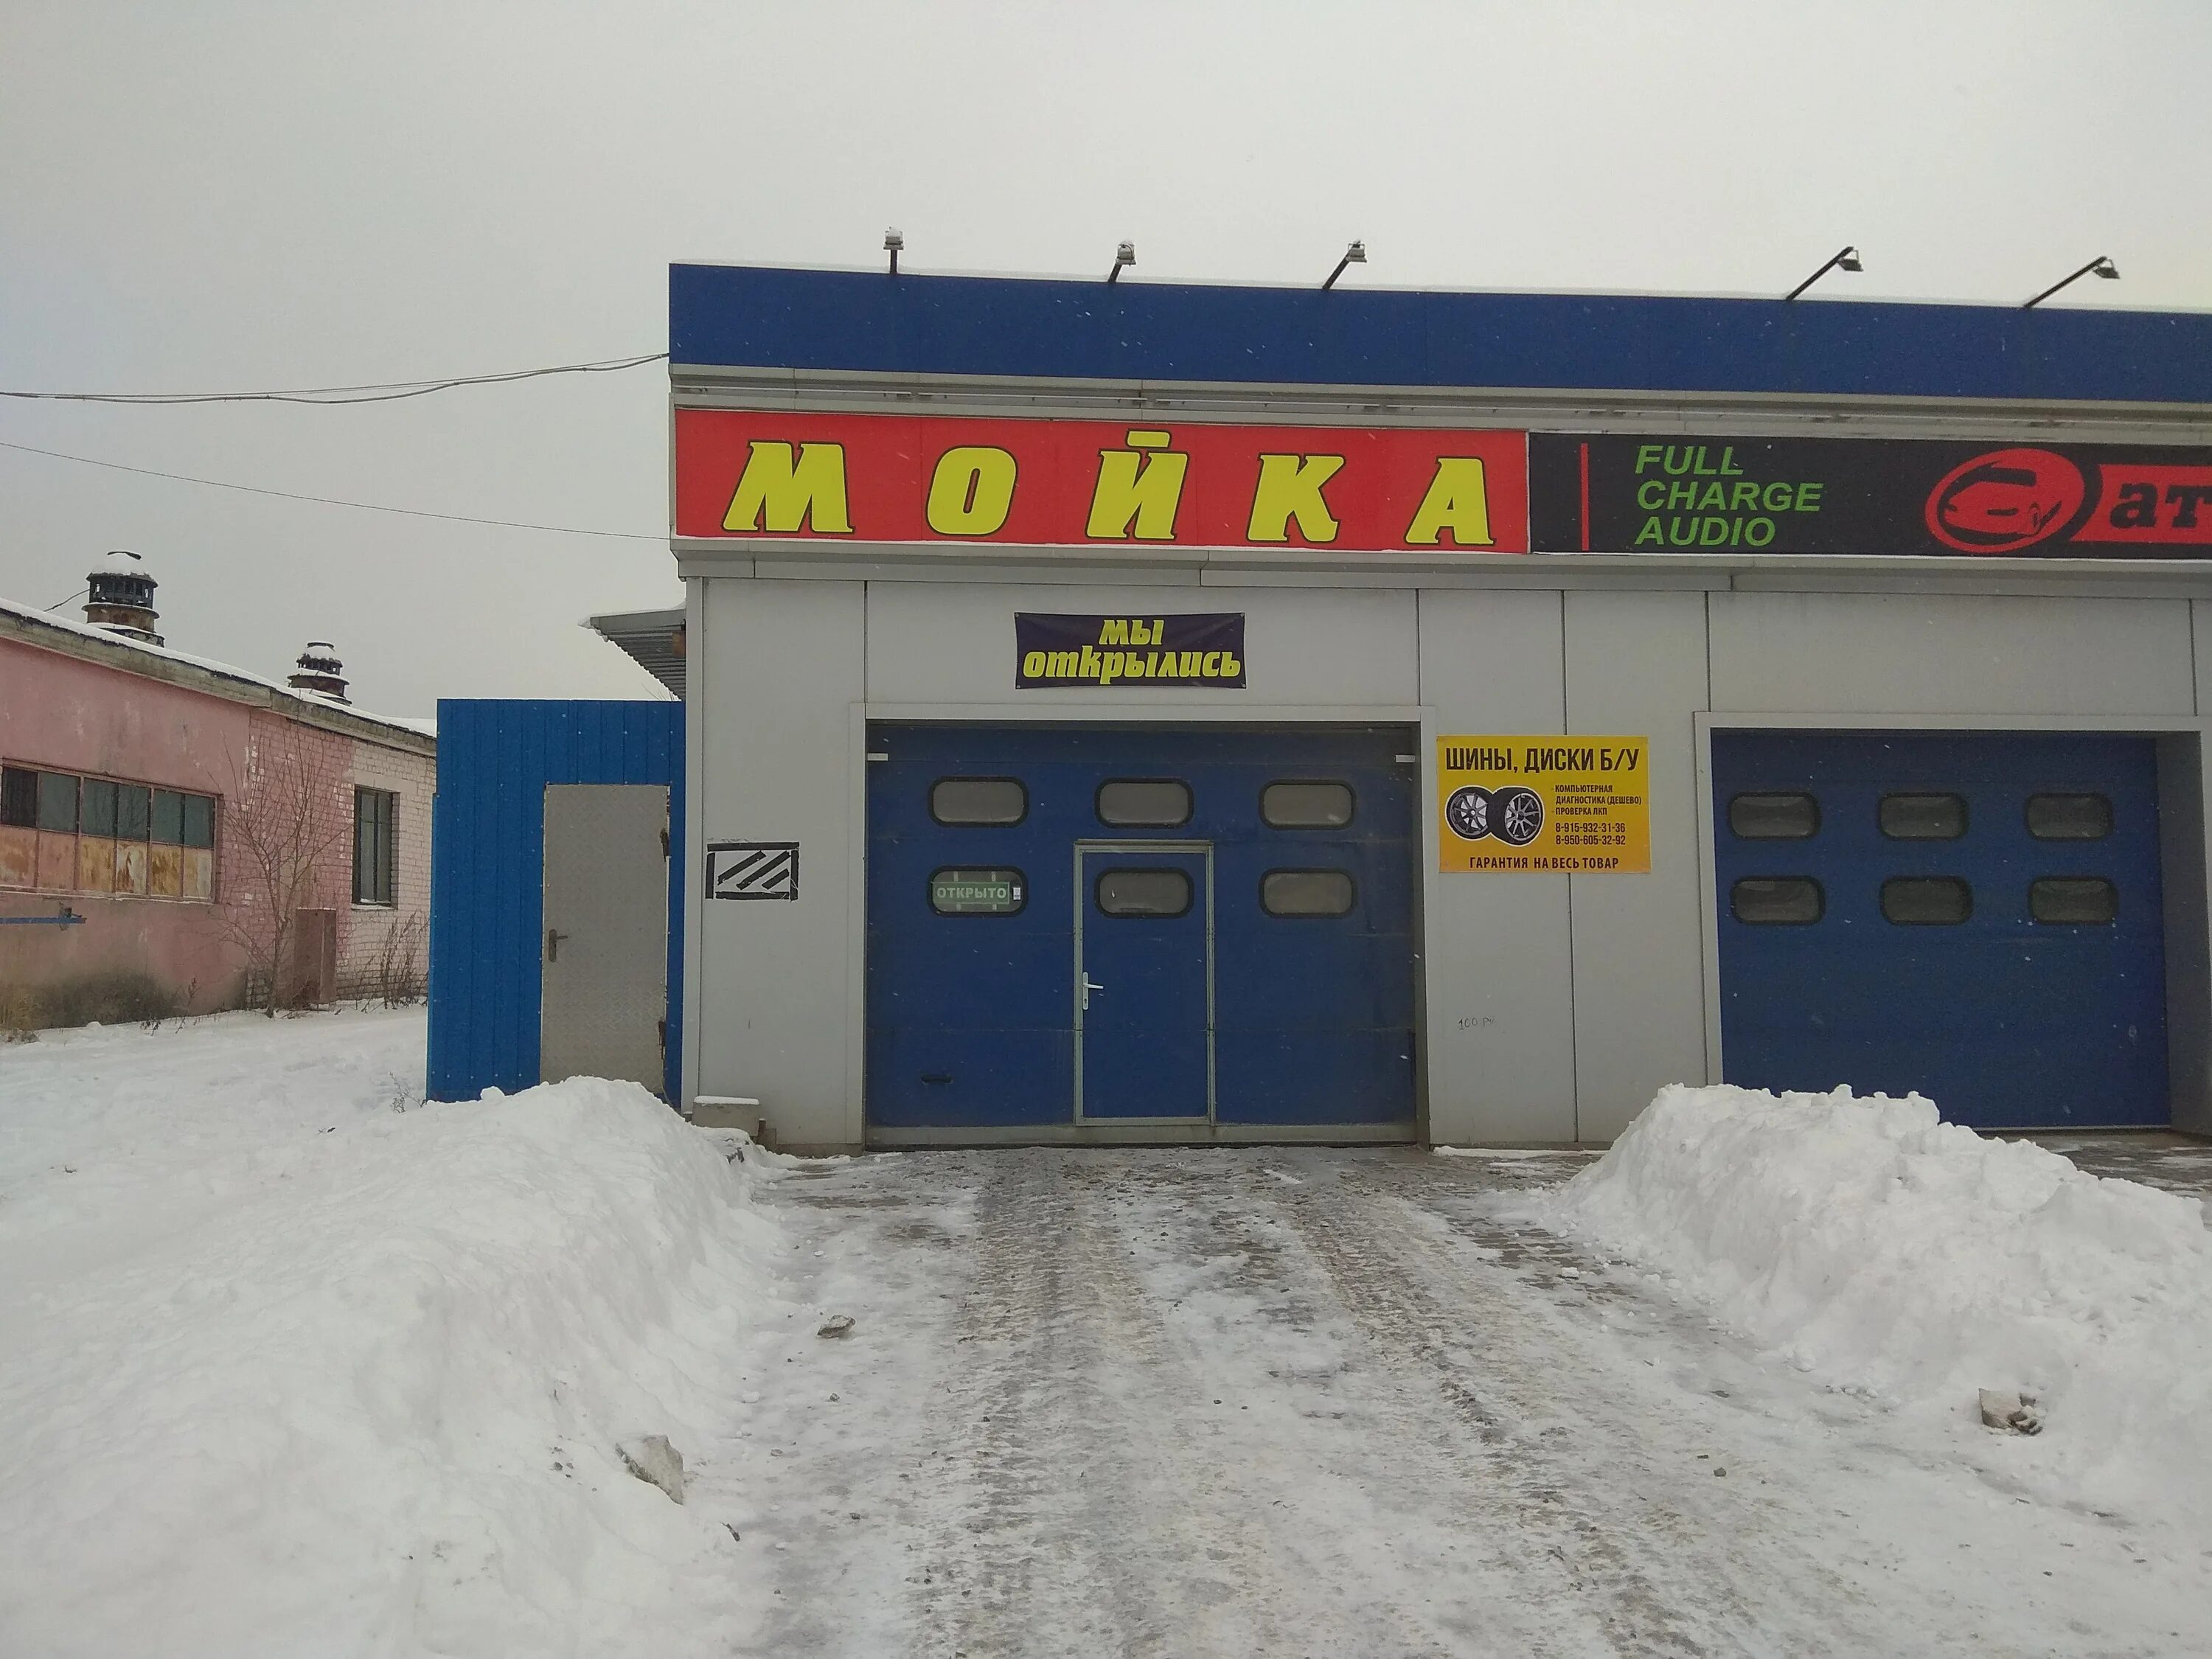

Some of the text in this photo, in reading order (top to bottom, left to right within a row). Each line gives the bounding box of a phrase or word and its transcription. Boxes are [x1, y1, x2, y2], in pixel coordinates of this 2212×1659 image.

[1635, 445, 1744, 475] FULL
[722, 430, 1496, 547] МОЙКА
[1638, 481, 1823, 512] CHARGE
[1635, 517, 1775, 546] AUDIO
[1446, 748, 1639, 773] ШИНЫ, ДИСКИ Б/У
[1556, 796, 1641, 805] ДИАГНОСТИКА (ДЕШЕВО)
[1556, 823, 1625, 832] 8-915-932-31-36
[1556, 835, 1625, 844] 8-950-605-32-92
[1470, 857, 1618, 869] ГАРАНТИЯ НА ВЕСЬ ТОВАР
[936, 887, 1006, 899] ОТКРЫТО
[1458, 1018, 1478, 1030] 100
